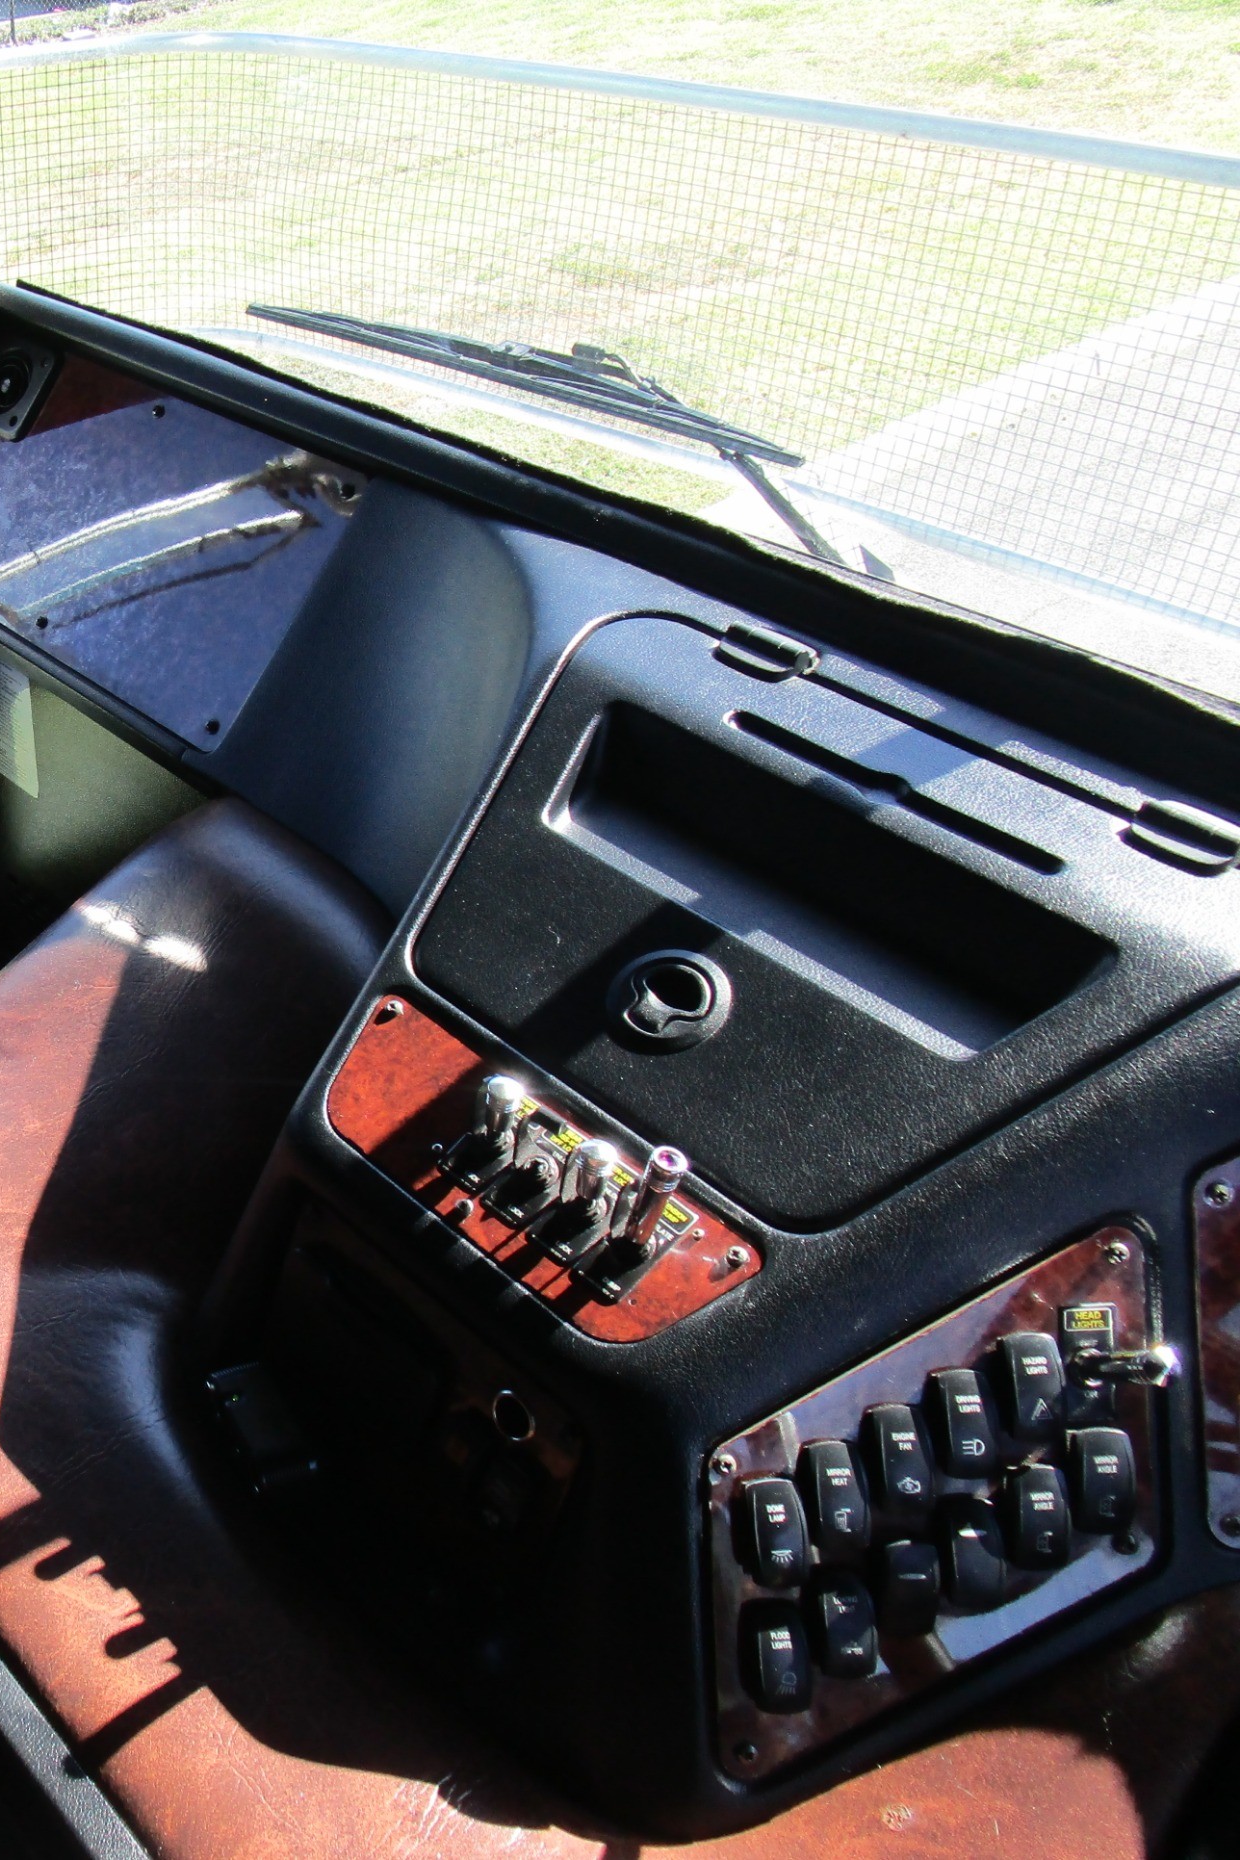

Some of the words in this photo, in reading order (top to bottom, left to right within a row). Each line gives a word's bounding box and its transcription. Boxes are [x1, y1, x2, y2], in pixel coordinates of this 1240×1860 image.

[1074, 1310, 1102, 1320] HEAD
[1071, 1320, 1106, 1329] LIGHTS
[891, 1431, 916, 1441] ENGINE
[898, 1441, 913, 1451] FAN
[831, 1477, 848, 1486] HEAT
[765, 1504, 786, 1513] DOME
[768, 1513, 787, 1523] LAMP
[770, 1630, 791, 1640] FLOOD
[771, 1640, 793, 1650] LIGHTS
